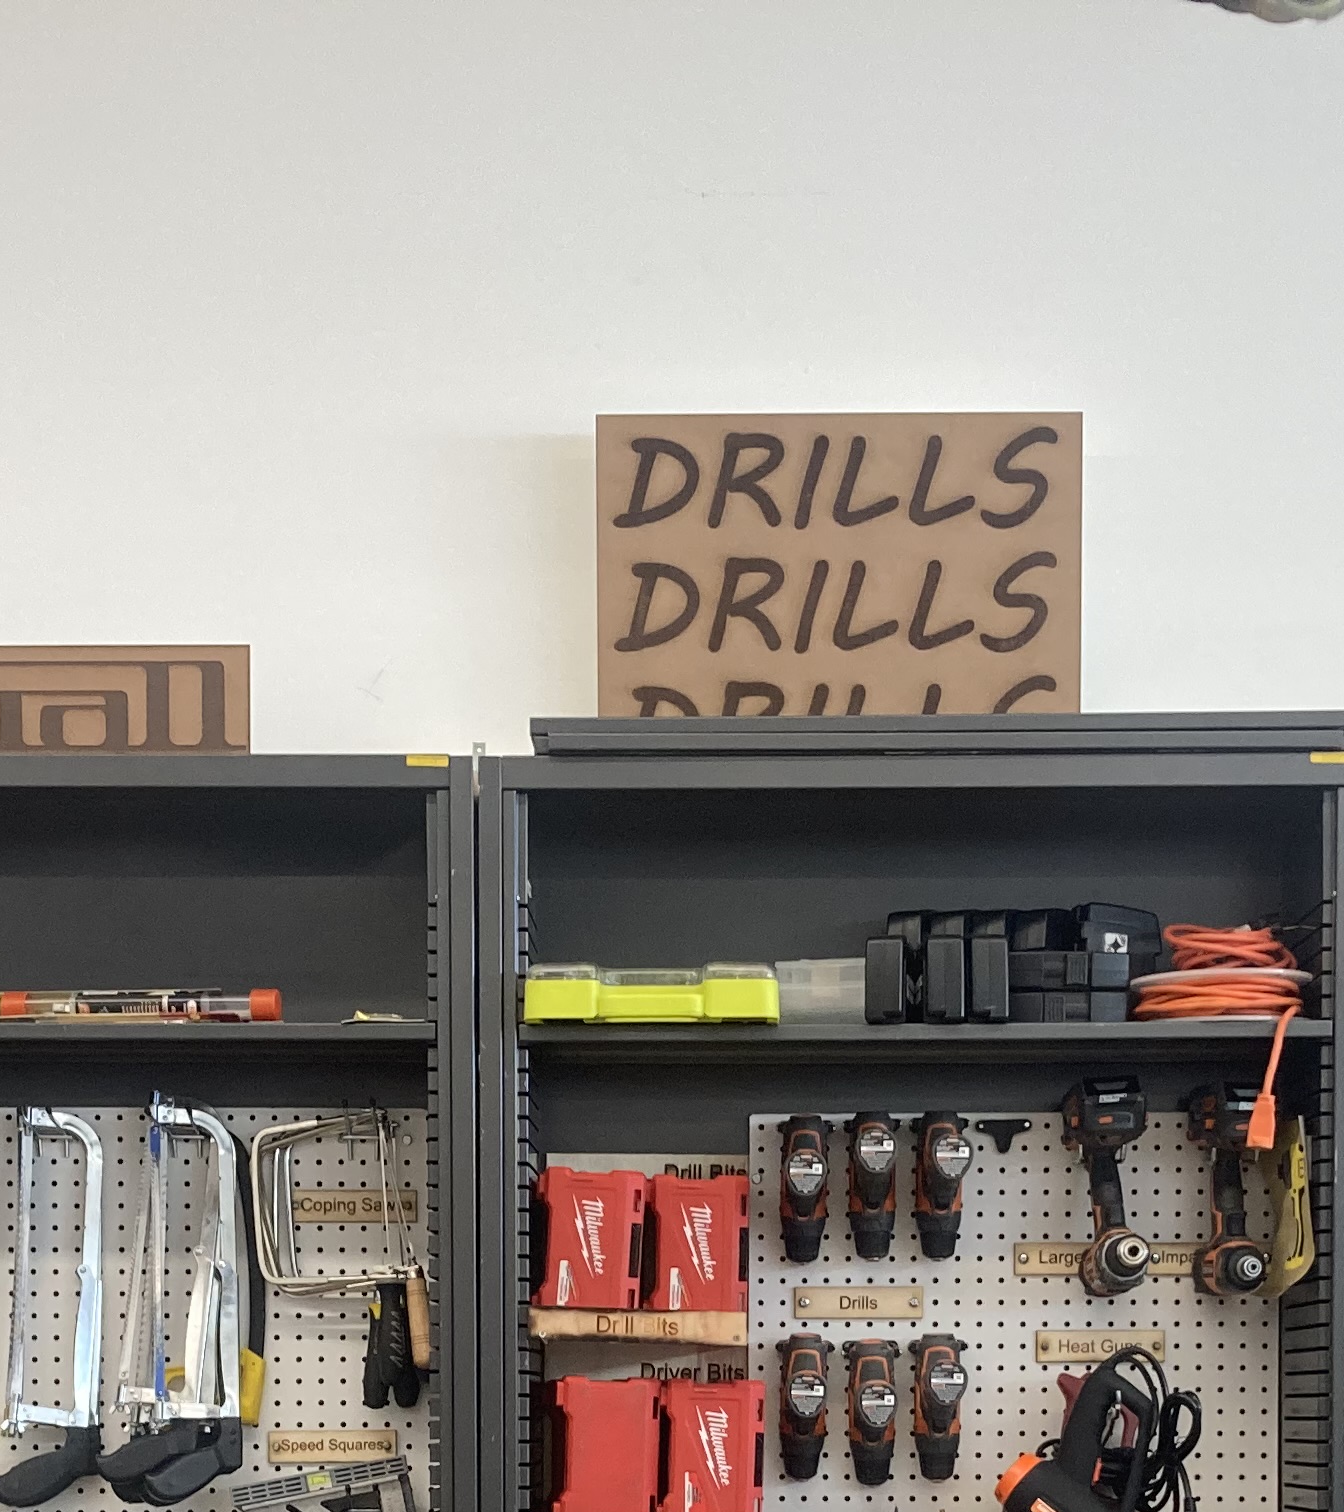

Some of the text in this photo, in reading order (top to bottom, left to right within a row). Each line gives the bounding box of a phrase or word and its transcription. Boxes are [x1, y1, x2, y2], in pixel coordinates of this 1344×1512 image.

[612, 426, 1059, 531] DRILLS
[613, 551, 1058, 655] DRILLS
[664, 1164, 747, 1180] Drill Bits
[300, 1197, 356, 1215] Coping
[582, 1196, 607, 1275] Milwaukee
[690, 1202, 717, 1281] Milwaukee
[1038, 1251, 1083, 1268] Large
[839, 1296, 878, 1310] Drills
[597, 1315, 634, 1334] Drill
[1058, 1339, 1095, 1354] Heat
[641, 1362, 744, 1382] Driver Bits
[281, 1438, 384, 1453] Speed Squares
[705, 1406, 733, 1486] Milwaukee
